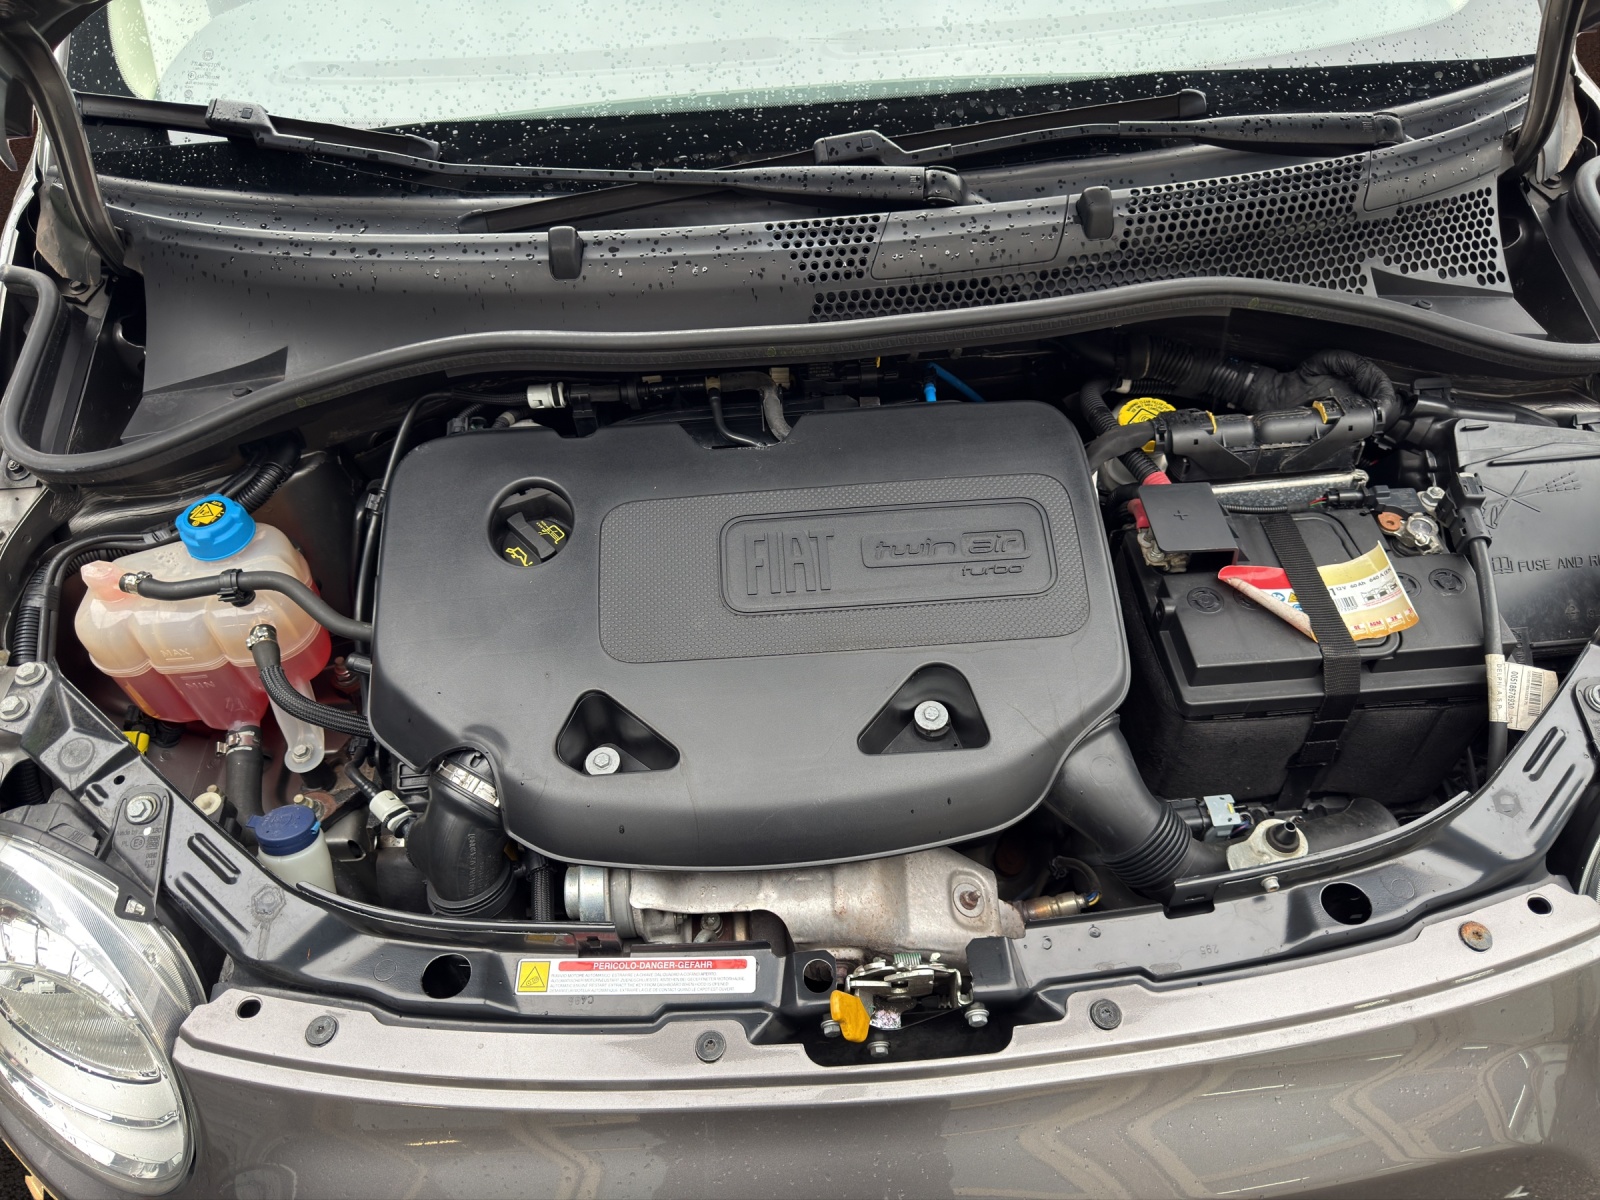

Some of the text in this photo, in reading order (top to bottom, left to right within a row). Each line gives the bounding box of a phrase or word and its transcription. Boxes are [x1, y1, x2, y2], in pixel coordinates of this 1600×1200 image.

[744, 530, 835, 595] FIAT
[1518, 559, 1552, 572] FUSE
[1558, 556, 1584, 570] AND
[961, 564, 1024, 577] turbo
[160, 648, 190, 657] MAX
[185, 680, 216, 689] MIN
[593, 961, 713, 970] PERICOLO-DANGER-GEFAHR
